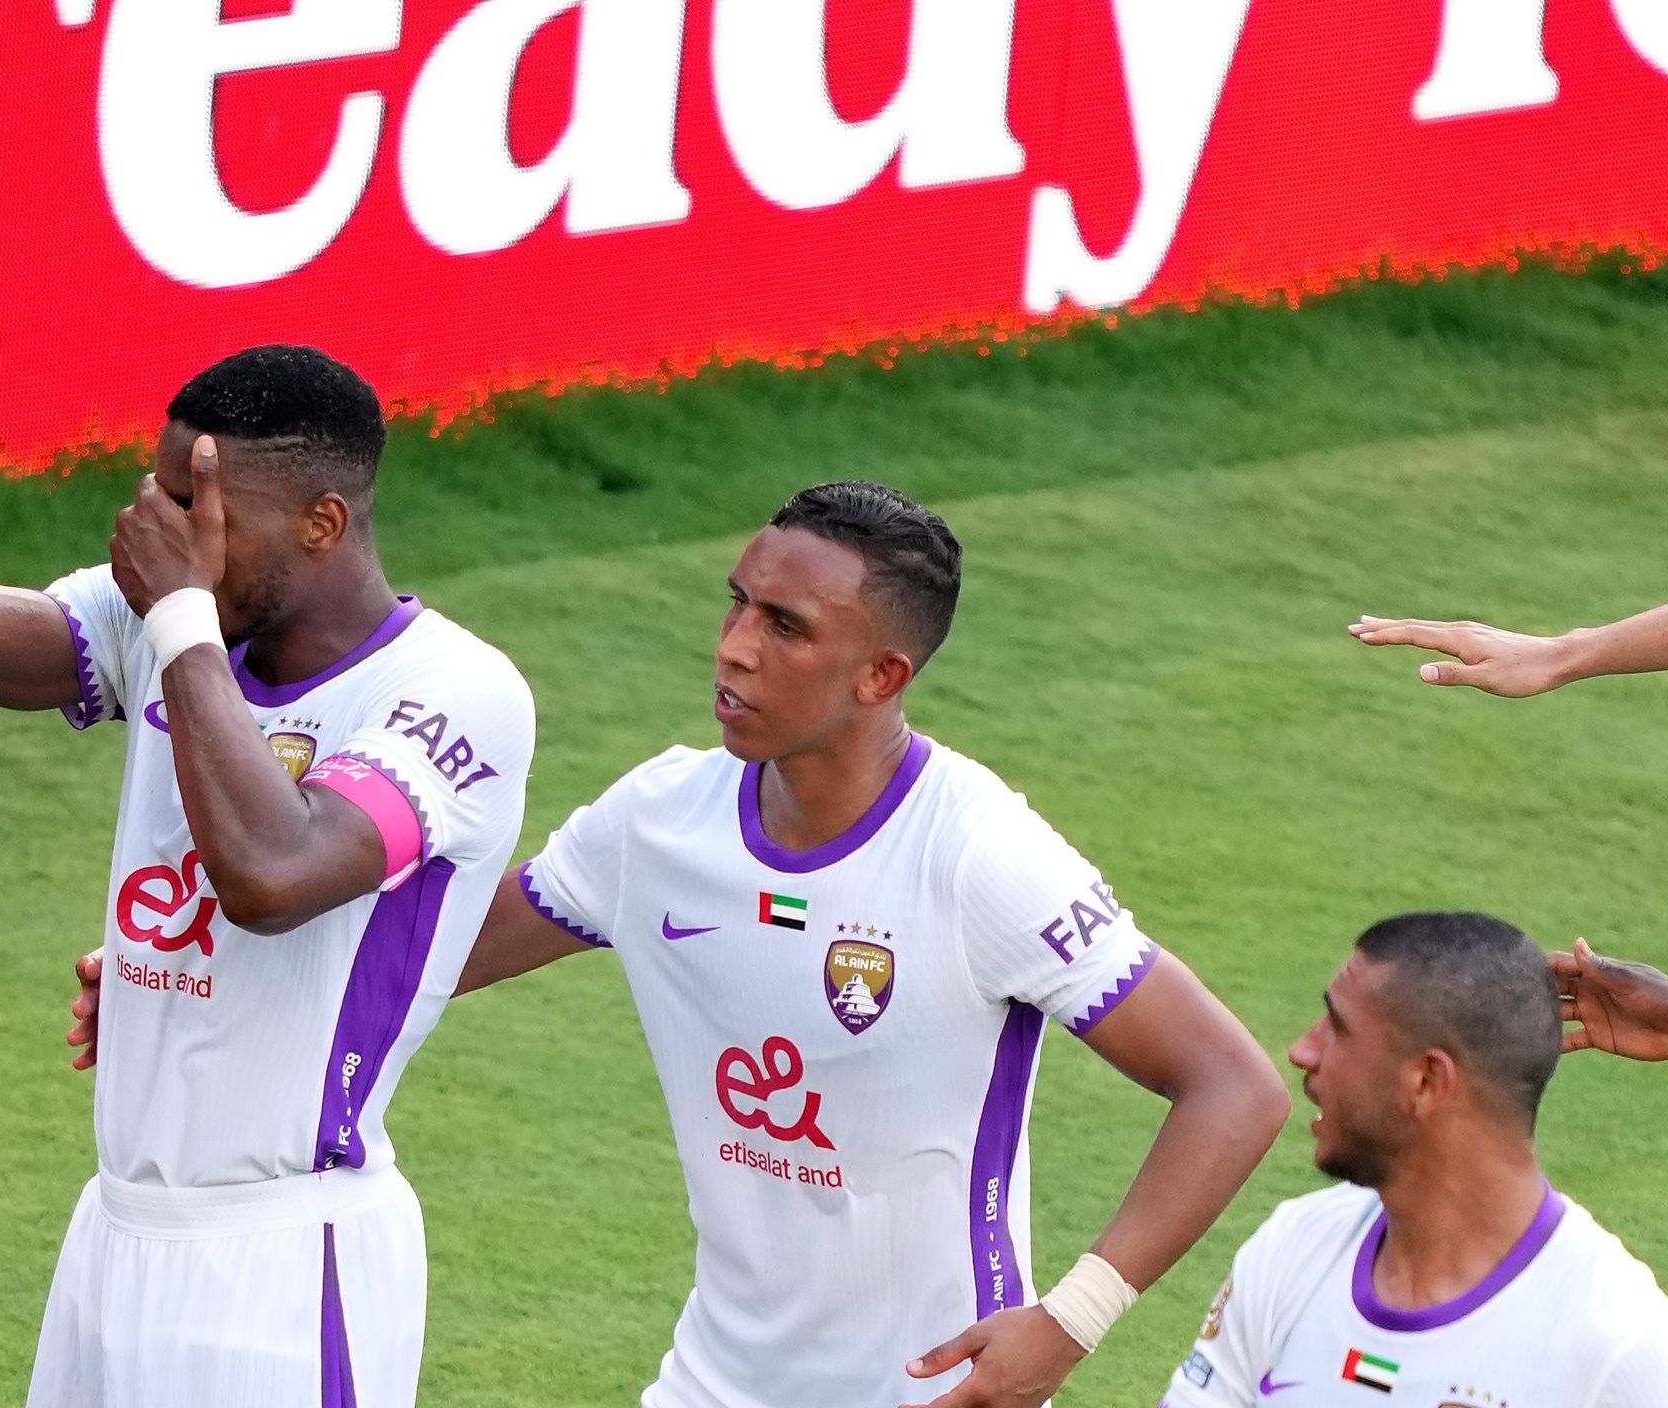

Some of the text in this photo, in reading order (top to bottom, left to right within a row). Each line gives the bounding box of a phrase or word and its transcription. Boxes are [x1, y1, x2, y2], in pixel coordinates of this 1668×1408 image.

[177, 972, 213, 999] and
[339, 1125, 352, 1146] FC
[719, 1141, 843, 1188] etisalat and
[986, 1177, 1000, 1222] 1968
[989, 1250, 1002, 1271] FC
[993, 1274, 1005, 1301] AIN
